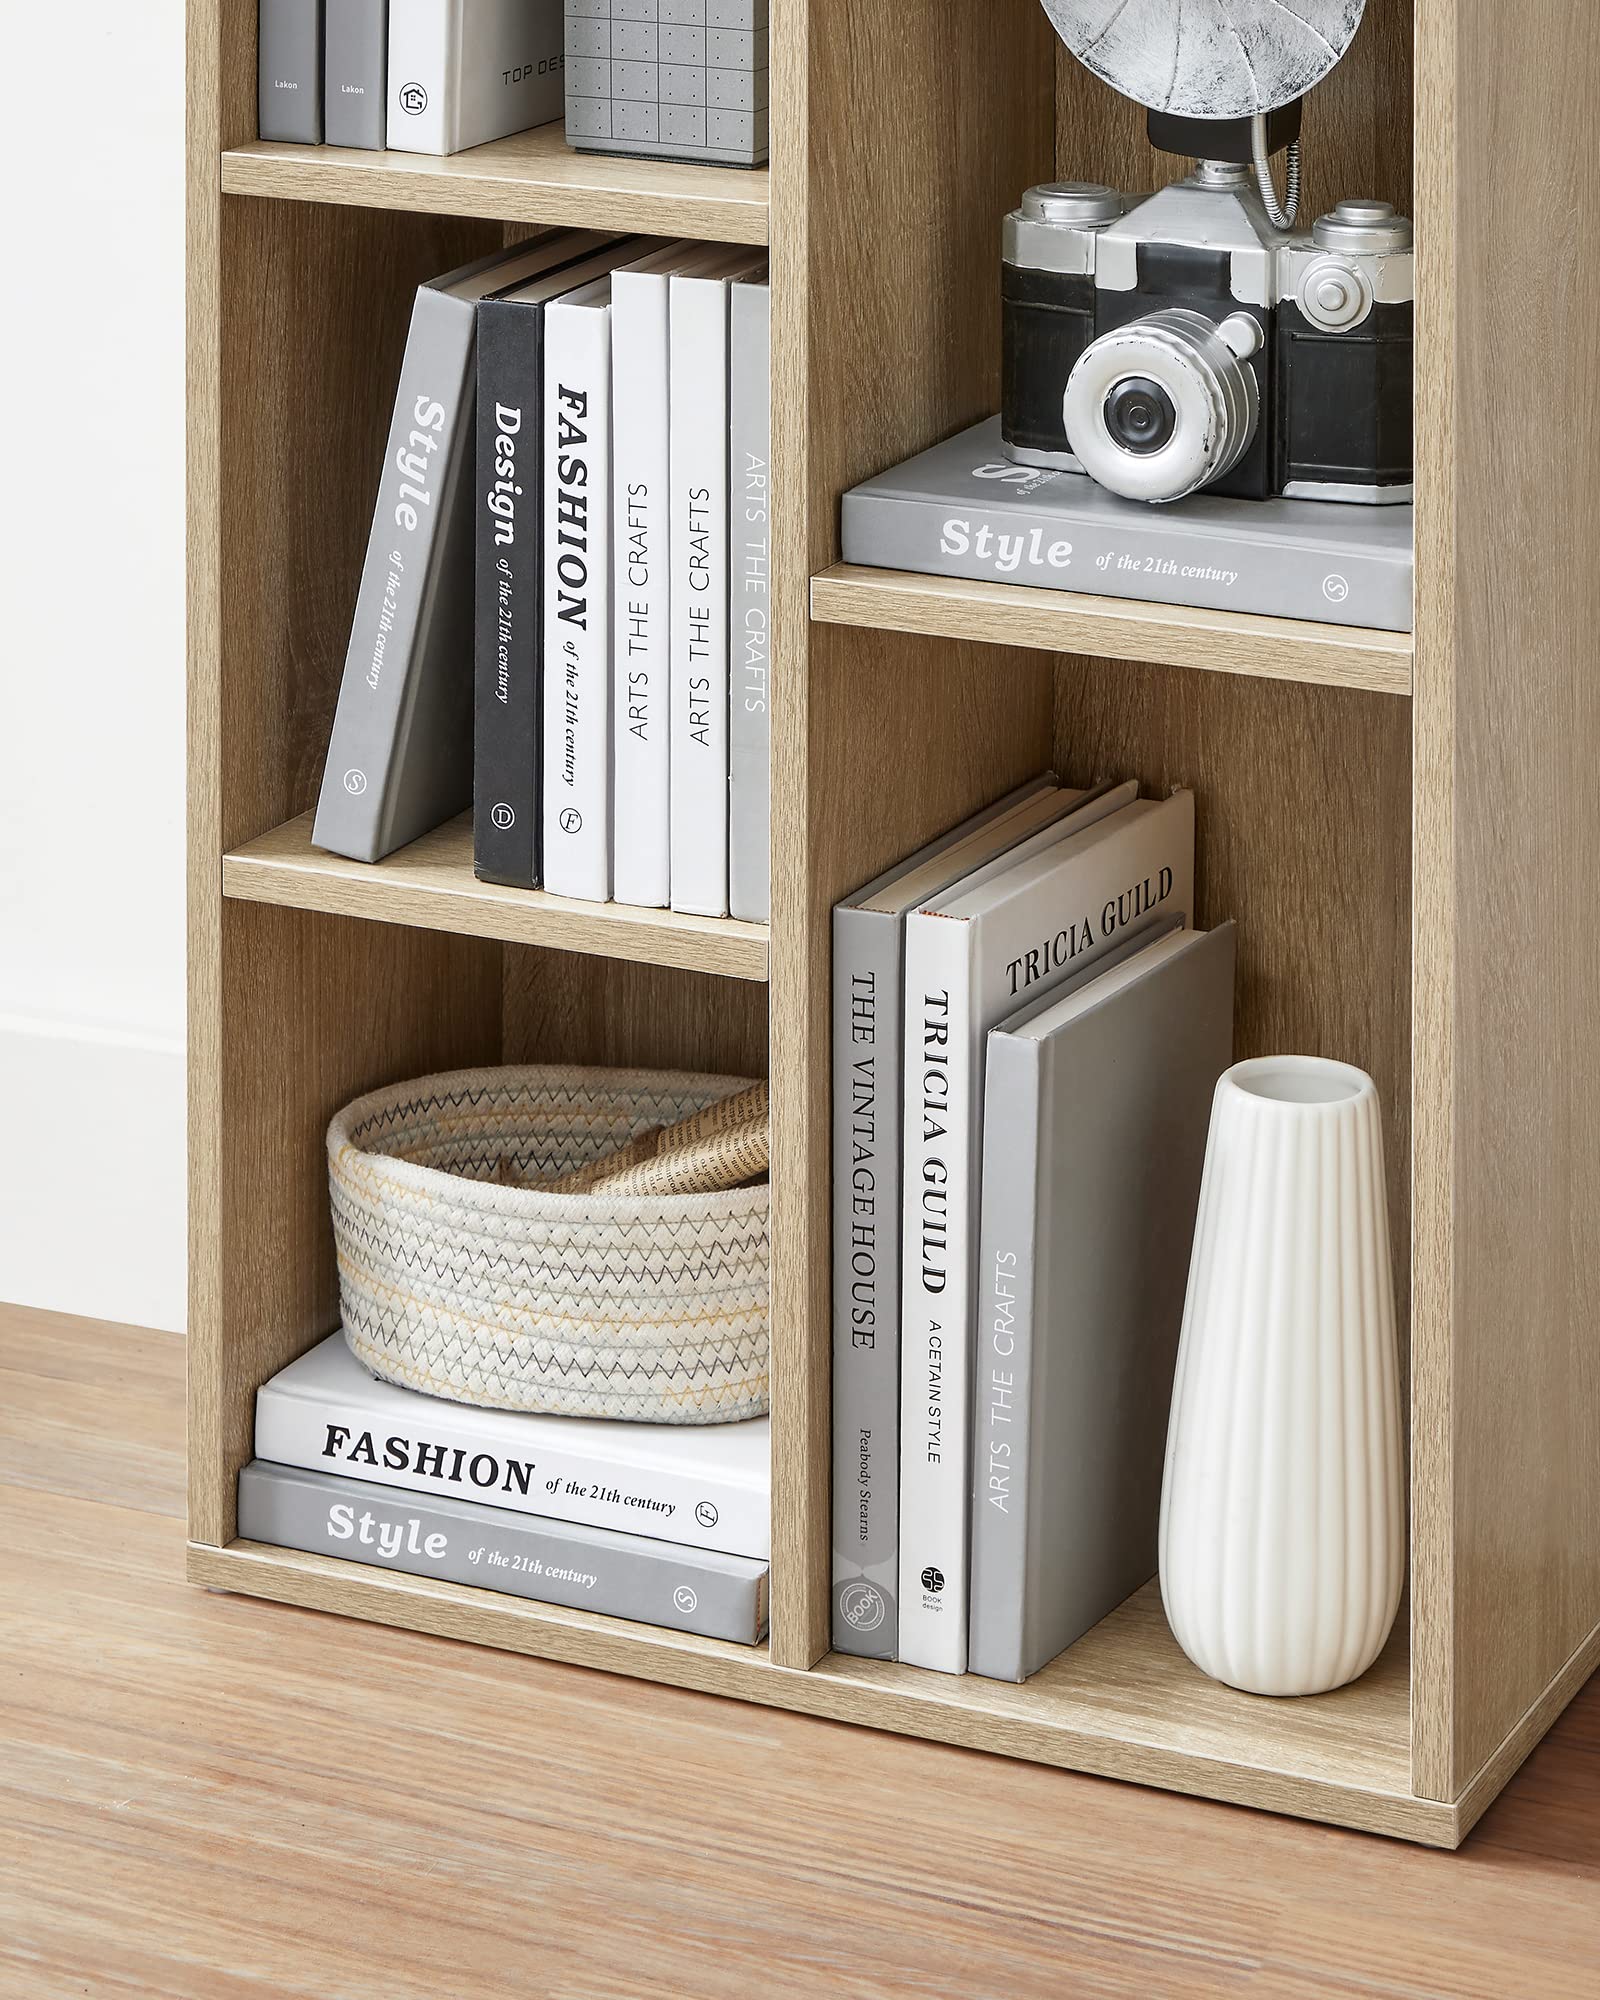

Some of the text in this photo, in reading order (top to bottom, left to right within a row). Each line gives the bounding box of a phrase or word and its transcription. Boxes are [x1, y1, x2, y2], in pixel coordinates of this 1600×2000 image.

[274, 79, 298, 90] Lakon
[341, 84, 365, 95] Lakon
[502, 64, 533, 86] TOP
[365, 395, 446, 690] Style of the 21th century
[487, 401, 523, 704] Design of the 21th century
[557, 383, 588, 787] FASHION of the 21th century
[745, 451, 767, 713] ARTS THE CRAFTS
[939, 519, 1239, 586] Style of the 21th century
[628, 483, 649, 741] ARTS THE CRAFTS
[689, 488, 710, 747] ARTS THE CRAFTS
[1005, 866, 1173, 997] TRICIA GUILD
[851, 971, 876, 1349] THE VINTAGE HOUSE
[922, 989, 949, 1294] TRICIA GUILD
[928, 1336, 942, 1402] CETAIN
[989, 1250, 1017, 1514] ARTS THE CRAFTS
[321, 1424, 676, 1517] FASHION of the 21th century
[857, 1428, 872, 1542] Peabody Stearns
[928, 1405, 942, 1464] STYLE
[327, 1503, 598, 1589] Style of the 21th century
[846, 1589, 879, 1625] BOOK
[922, 1594, 943, 1604] BOOK
[922, 1602, 944, 1613] design
